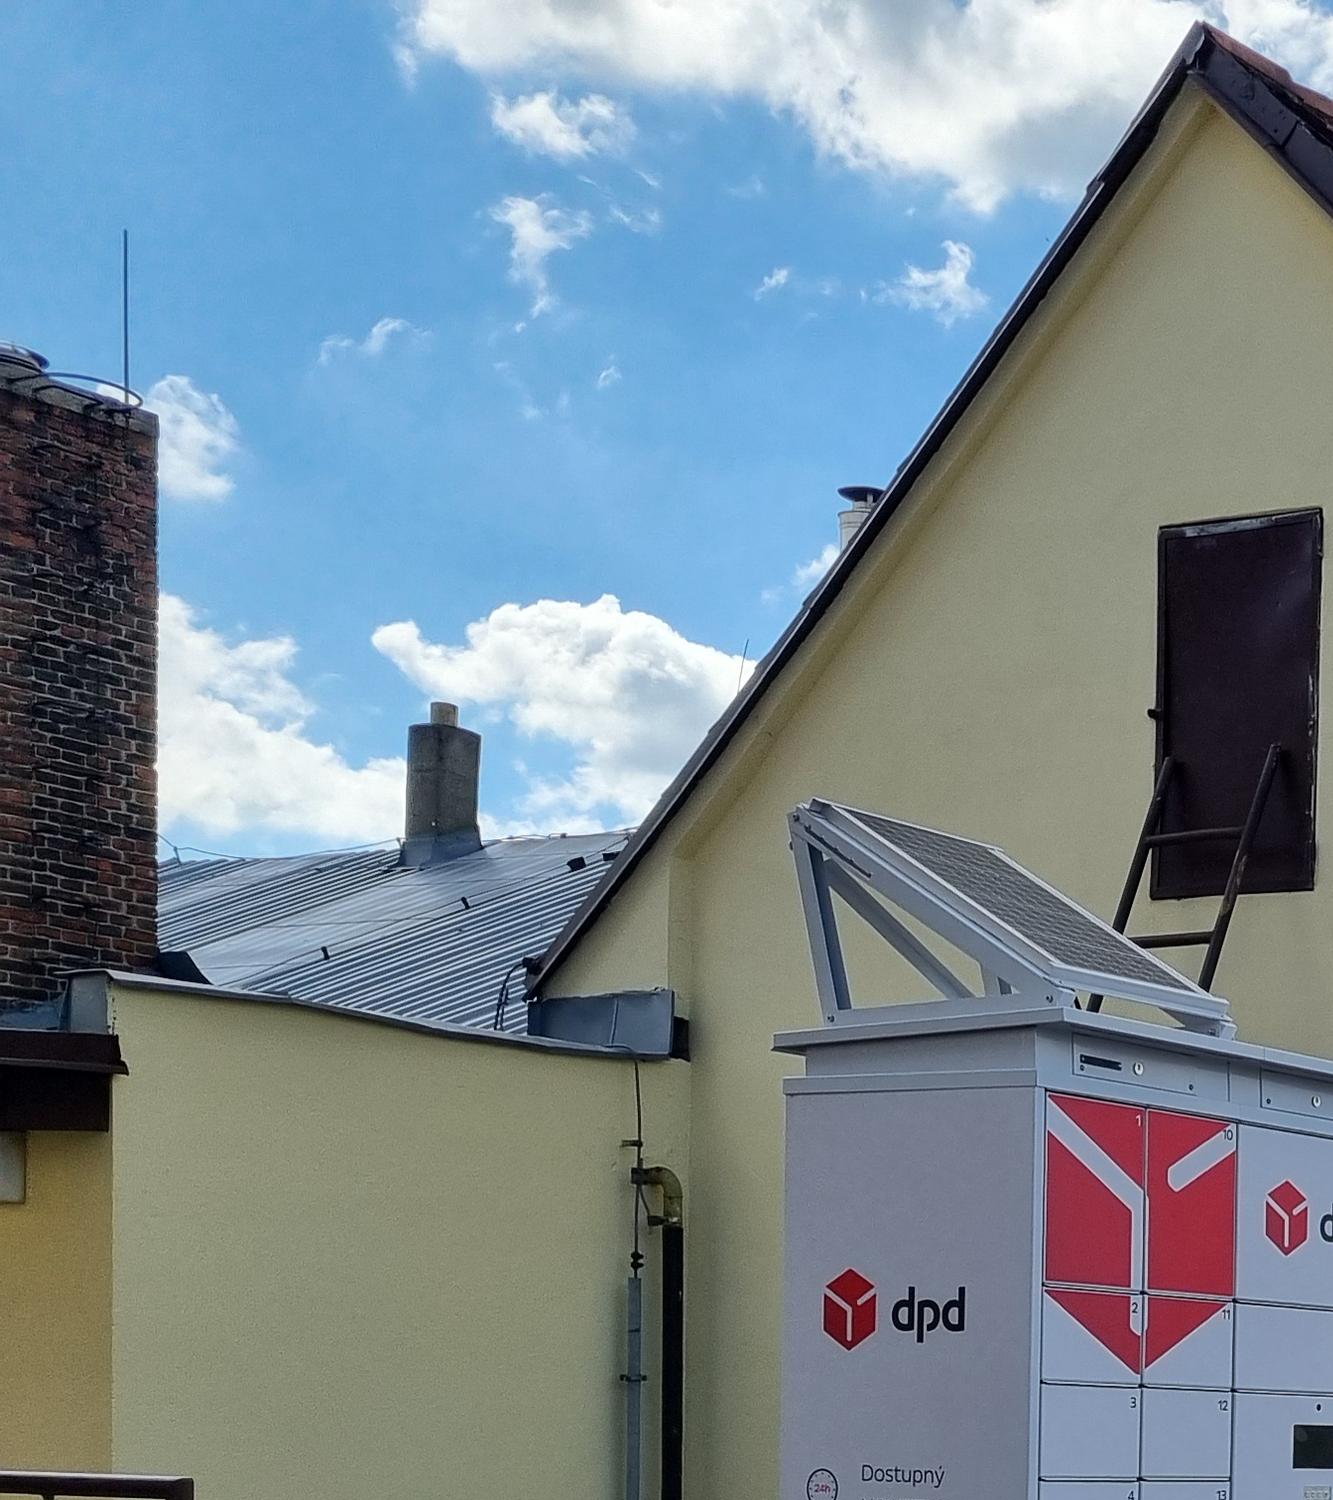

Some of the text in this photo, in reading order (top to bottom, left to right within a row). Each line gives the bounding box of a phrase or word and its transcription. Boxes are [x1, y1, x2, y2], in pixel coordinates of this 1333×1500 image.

[1136, 1114, 1142, 1127] 1
[1223, 1129, 1234, 1141] 10
[1131, 1302, 1139, 1314] 2
[891, 1286, 966, 1343] dpd
[1222, 1309, 1231, 1321] 11
[1129, 1397, 1137, 1409] 3
[1218, 1400, 1229, 1412] 12
[861, 1464, 945, 1488] Dostupný
